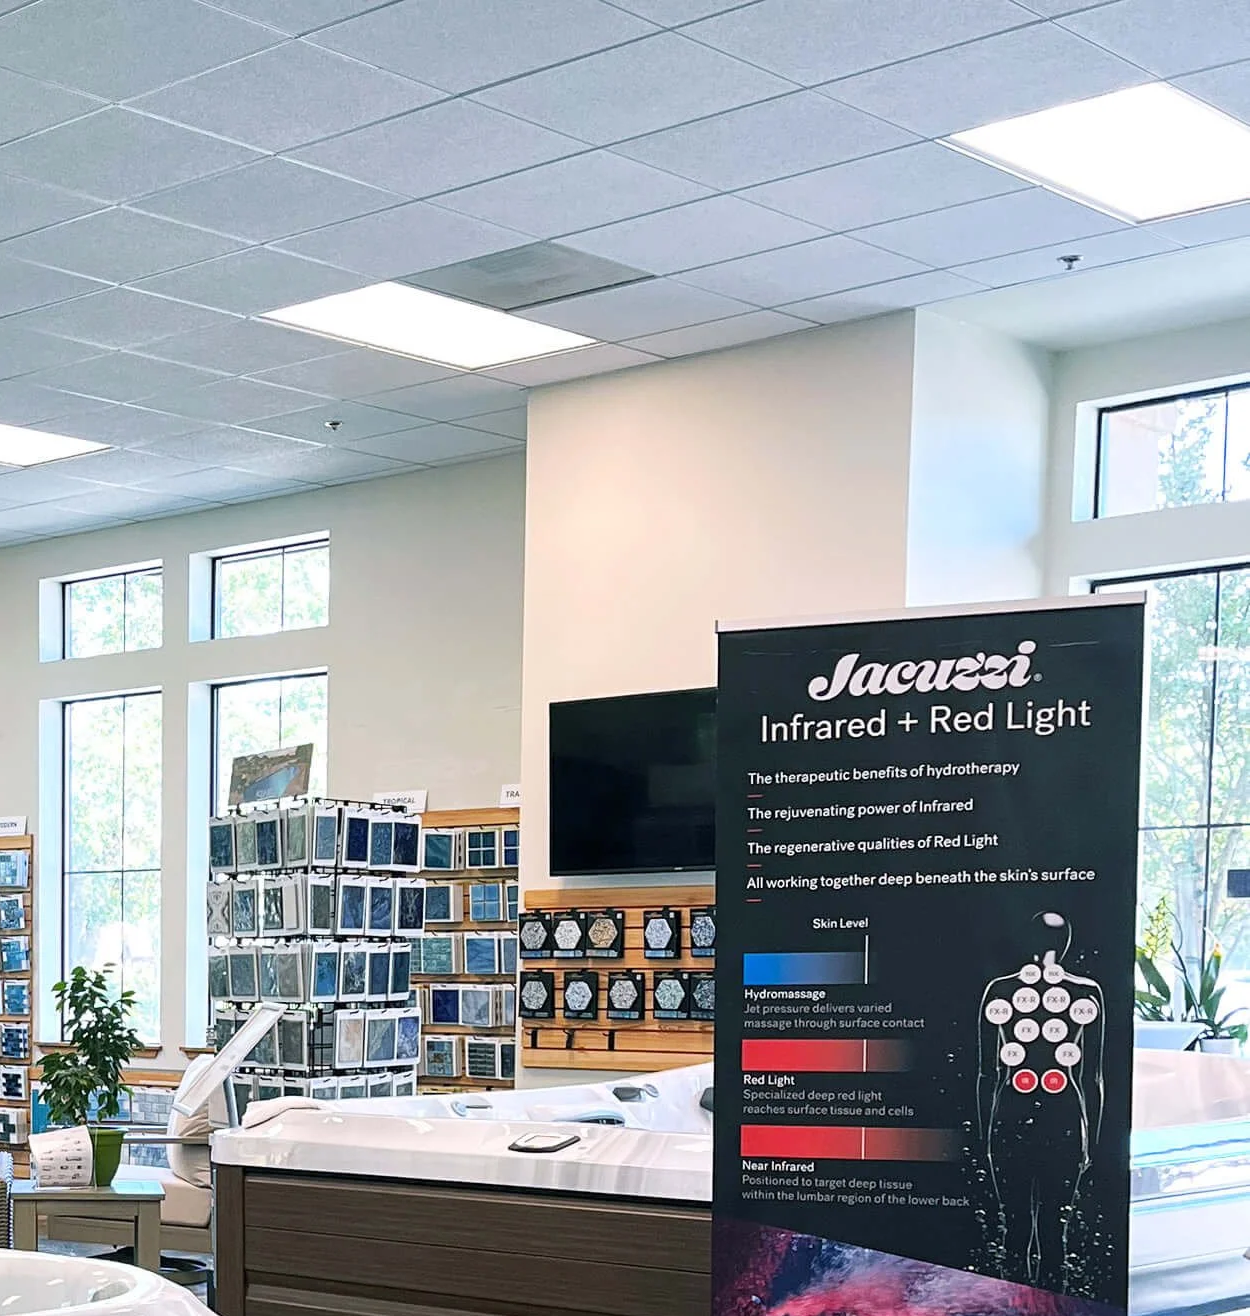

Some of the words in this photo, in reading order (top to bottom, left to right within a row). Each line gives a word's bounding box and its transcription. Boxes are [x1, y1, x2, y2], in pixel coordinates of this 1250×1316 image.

[808, 640, 1037, 701] Jacuzzi
[760, 709, 886, 743] Infrared
[897, 712, 919, 733] +
[930, 703, 993, 734] Red
[1007, 699, 1091, 736] Light
[748, 772, 772, 785] The
[775, 769, 851, 785] therapeutic
[852, 766, 908, 780] benefits
[909, 764, 925, 778] of
[927, 762, 1020, 779] hydrotherapy
[747, 807, 772, 819] The
[774, 804, 855, 821] rejuvenating
[858, 804, 900, 818] power
[902, 801, 918, 814] of
[919, 798, 974, 813] Infrared
[747, 842, 772, 854] The
[774, 839, 855, 856] regenerative
[857, 837, 915, 853] qualities
[917, 835, 932, 849] of
[934, 834, 961, 848] Red
[964, 834, 999, 849] Light
[746, 877, 764, 889] All
[766, 875, 818, 890] working
[820, 874, 877, 890] together
[878, 872, 913, 887] deep
[916, 870, 971, 885] beneath
[974, 869, 997, 882] the
[999, 868, 1039, 882] skin's
[1041, 867, 1095, 881] surface
[813, 918, 838, 929] Skin
[839, 917, 869, 929] Level
[744, 988, 826, 1001] Hydromassage
[744, 1003, 760, 1014] Jet
[762, 1004, 810, 1015] pressure
[812, 1003, 856, 1014] delivers
[857, 1002, 892, 1013] varied
[744, 1019, 792, 1030] massage
[794, 1018, 837, 1031] through
[839, 1017, 880, 1028] surface
[882, 1018, 925, 1028] contact
[743, 1074, 765, 1085] Red
[767, 1075, 795, 1087] Light
[742, 1089, 805, 1101] Specialized
[807, 1090, 835, 1101] deep
[837, 1090, 855, 1101] red
[857, 1090, 882, 1103] light
[742, 1104, 785, 1114] reaches
[787, 1104, 828, 1115] surface
[830, 1105, 862, 1115] tissue
[864, 1105, 886, 1116] and
[888, 1105, 914, 1116] cells
[742, 1160, 769, 1171] Near
[771, 1160, 815, 1172] Infrared
[742, 1174, 799, 1186] Positioned
[801, 1176, 812, 1187] to
[814, 1177, 847, 1190] target
[848, 1178, 877, 1190] deep
[879, 1179, 913, 1190] tissue
[741, 1190, 775, 1200] within
[777, 1190, 795, 1201] the
[796, 1191, 835, 1202] lumbar
[837, 1193, 871, 1205] region
[874, 1193, 886, 1204] of
[887, 1194, 906, 1205] the
[908, 1194, 940, 1206] lower
[942, 1195, 970, 1206] back
